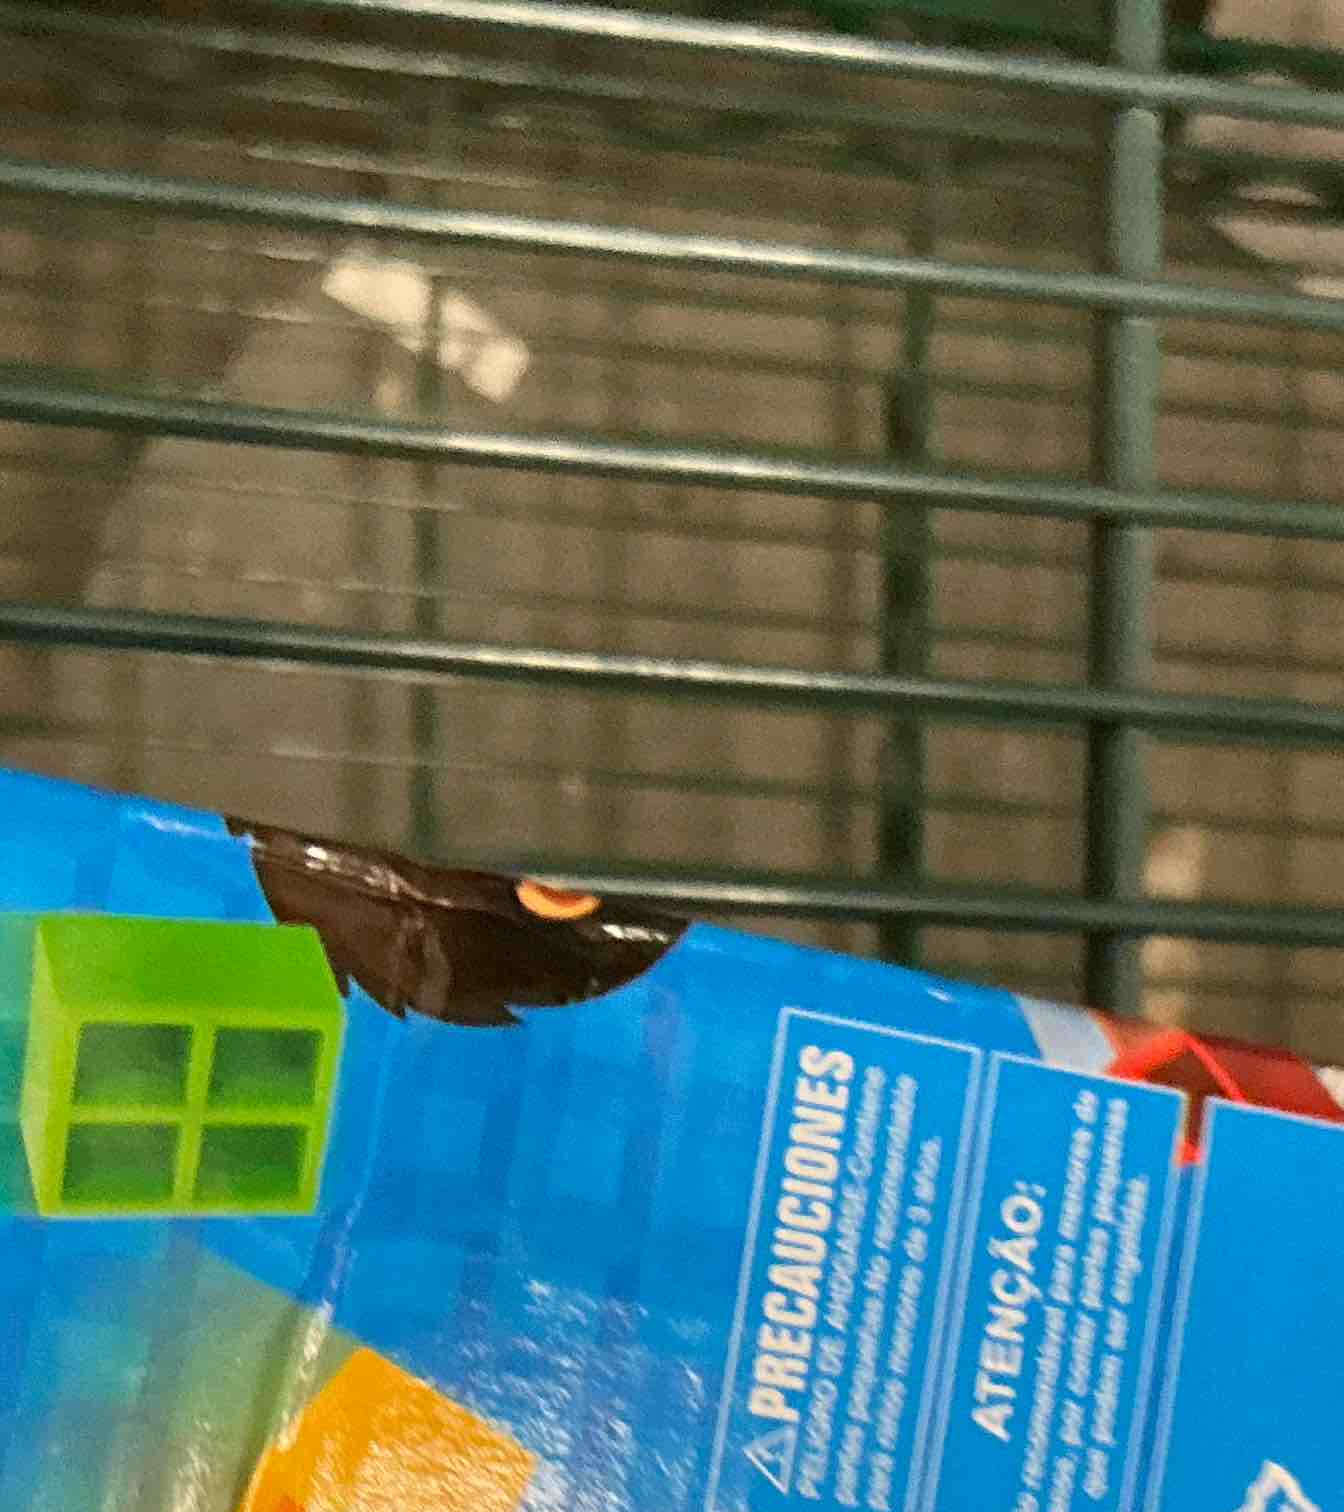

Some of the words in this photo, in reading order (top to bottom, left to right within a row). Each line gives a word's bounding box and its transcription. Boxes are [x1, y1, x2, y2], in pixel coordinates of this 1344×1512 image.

[1073, 1089, 1099, 1124] de
[1058, 1128, 1093, 1239] menores
[1092, 1098, 1128, 1225] pequenas
[749, 1047, 852, 1421] PRECAUCIONES
[902, 1227, 928, 1261] de
[907, 1205, 931, 1224] 3
[834, 1424, 865, 1507] partes
[874, 1074, 917, 1250] recomendable
[972, 1182, 1044, 1440] ATENÇÃO:
[1048, 1244, 1076, 1304] para
[1079, 1227, 1109, 1311] partes
[888, 1266, 922, 1374] menores
[1066, 1313, 1096, 1396] conter
[1104, 1306, 1128, 1350] ser
[796, 1378, 837, 1499] PELIGRO
[817, 1337, 845, 1375] DE
[875, 1379, 906, 1450] niños
[1022, 1305, 1066, 1489] recomendável
[1059, 1399, 1084, 1447] por
[1091, 1354, 1122, 1444] podem
[866, 1452, 894, 1512] para
